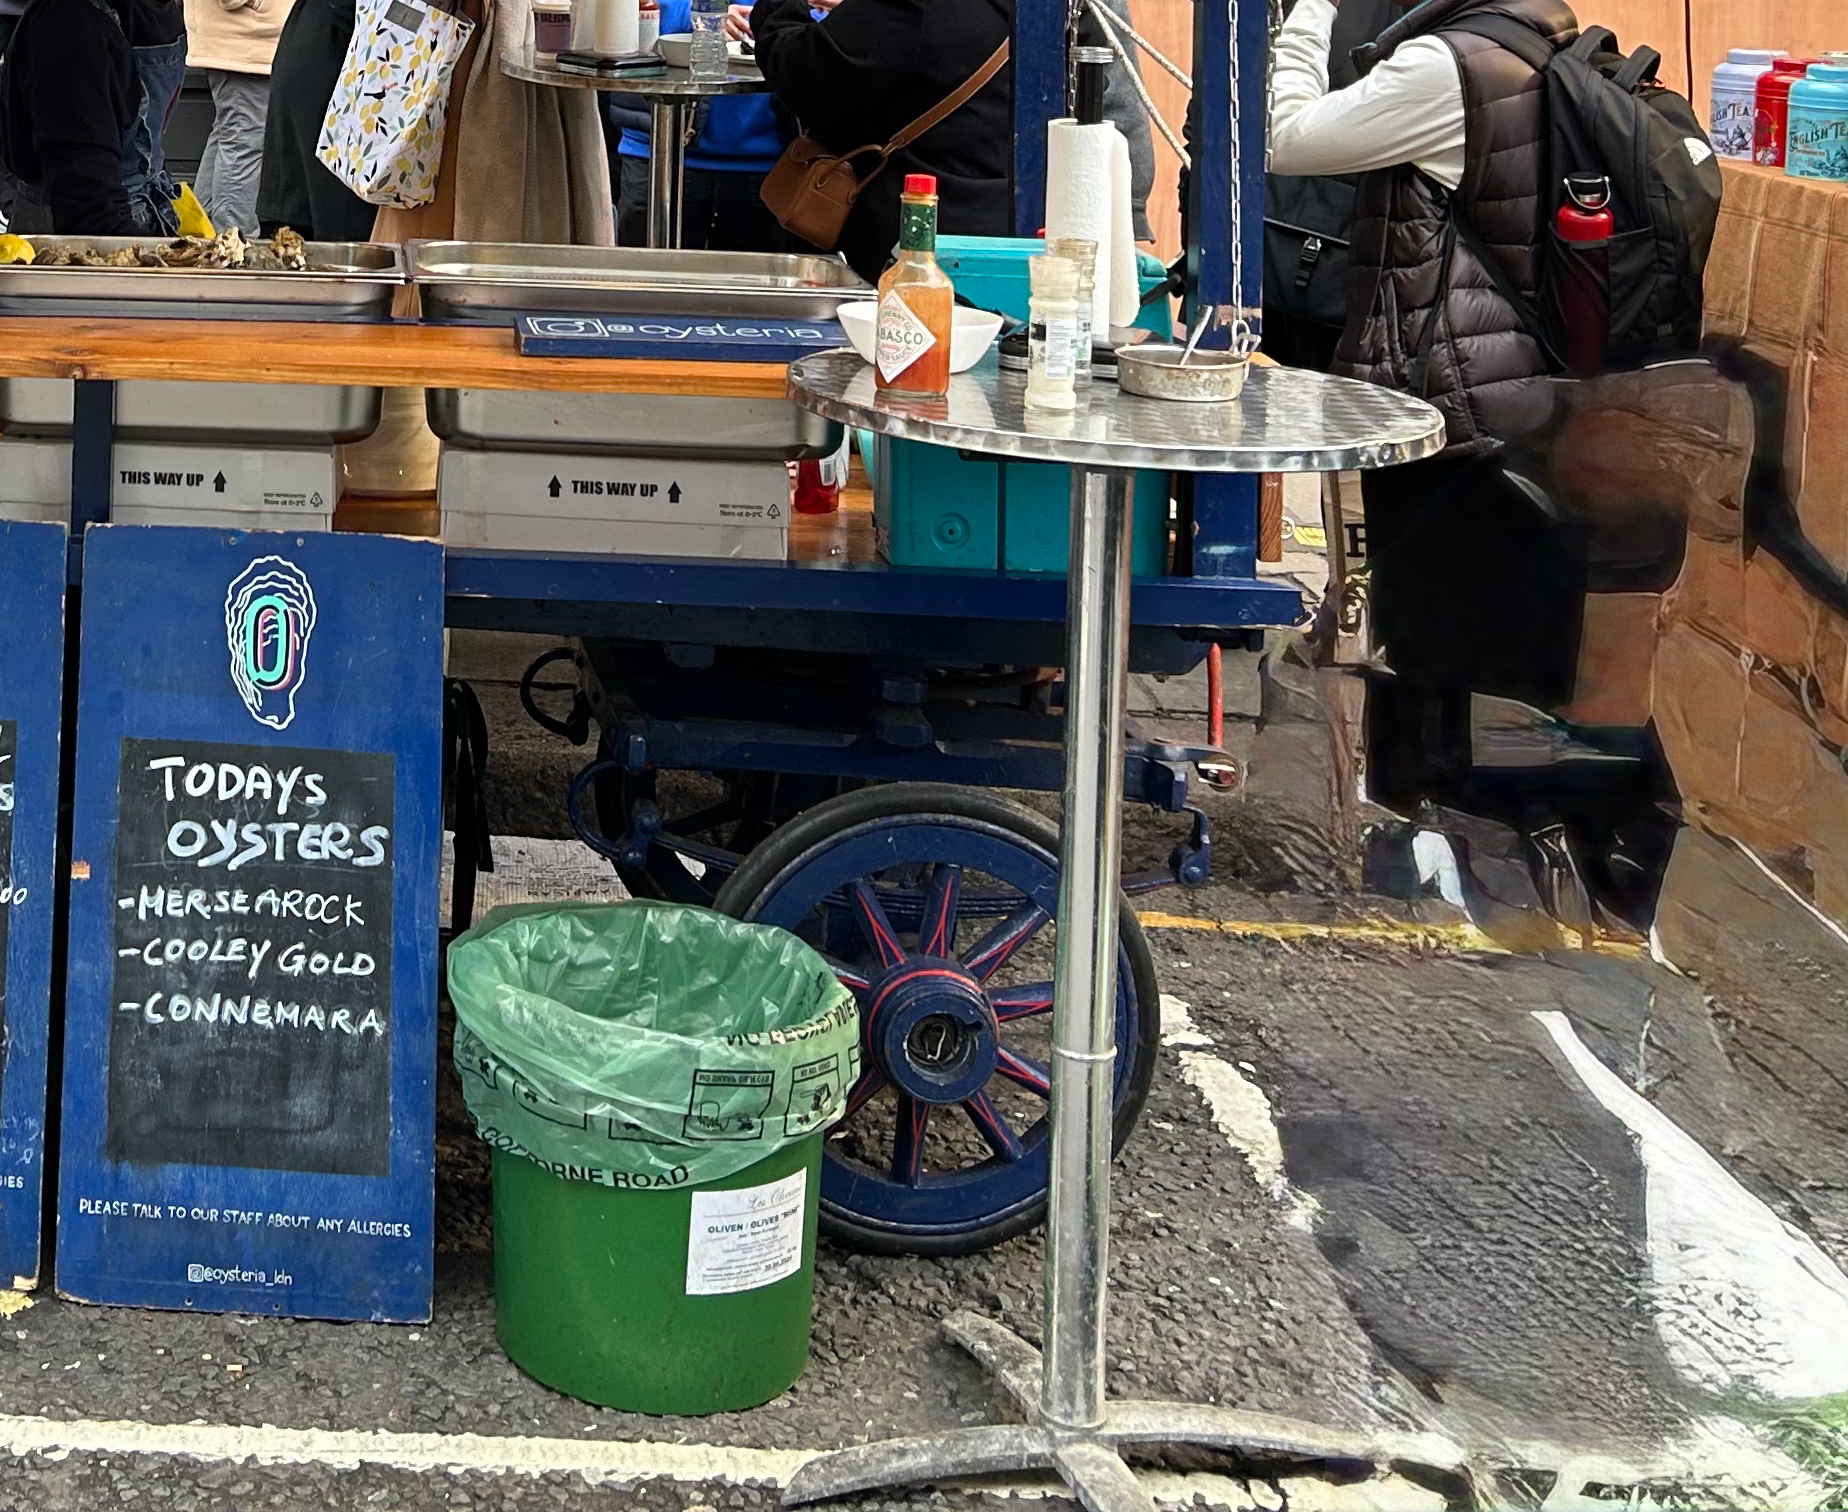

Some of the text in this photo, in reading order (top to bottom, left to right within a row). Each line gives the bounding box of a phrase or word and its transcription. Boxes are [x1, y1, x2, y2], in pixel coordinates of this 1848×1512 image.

[878, 328, 923, 345] BASCO
[120, 470, 204, 487] THIS WAY UP
[571, 480, 658, 498] THIS WAY UP
[149, 756, 328, 815] TODAYS
[167, 818, 390, 871] OYSTERS
[278, 942, 376, 977] GOLD
[613, 1164, 689, 1188] ROAD
[79, 1198, 412, 1238] PLEASE TALK TO OUR STAFF ABOUT ANY ALLERGIES
